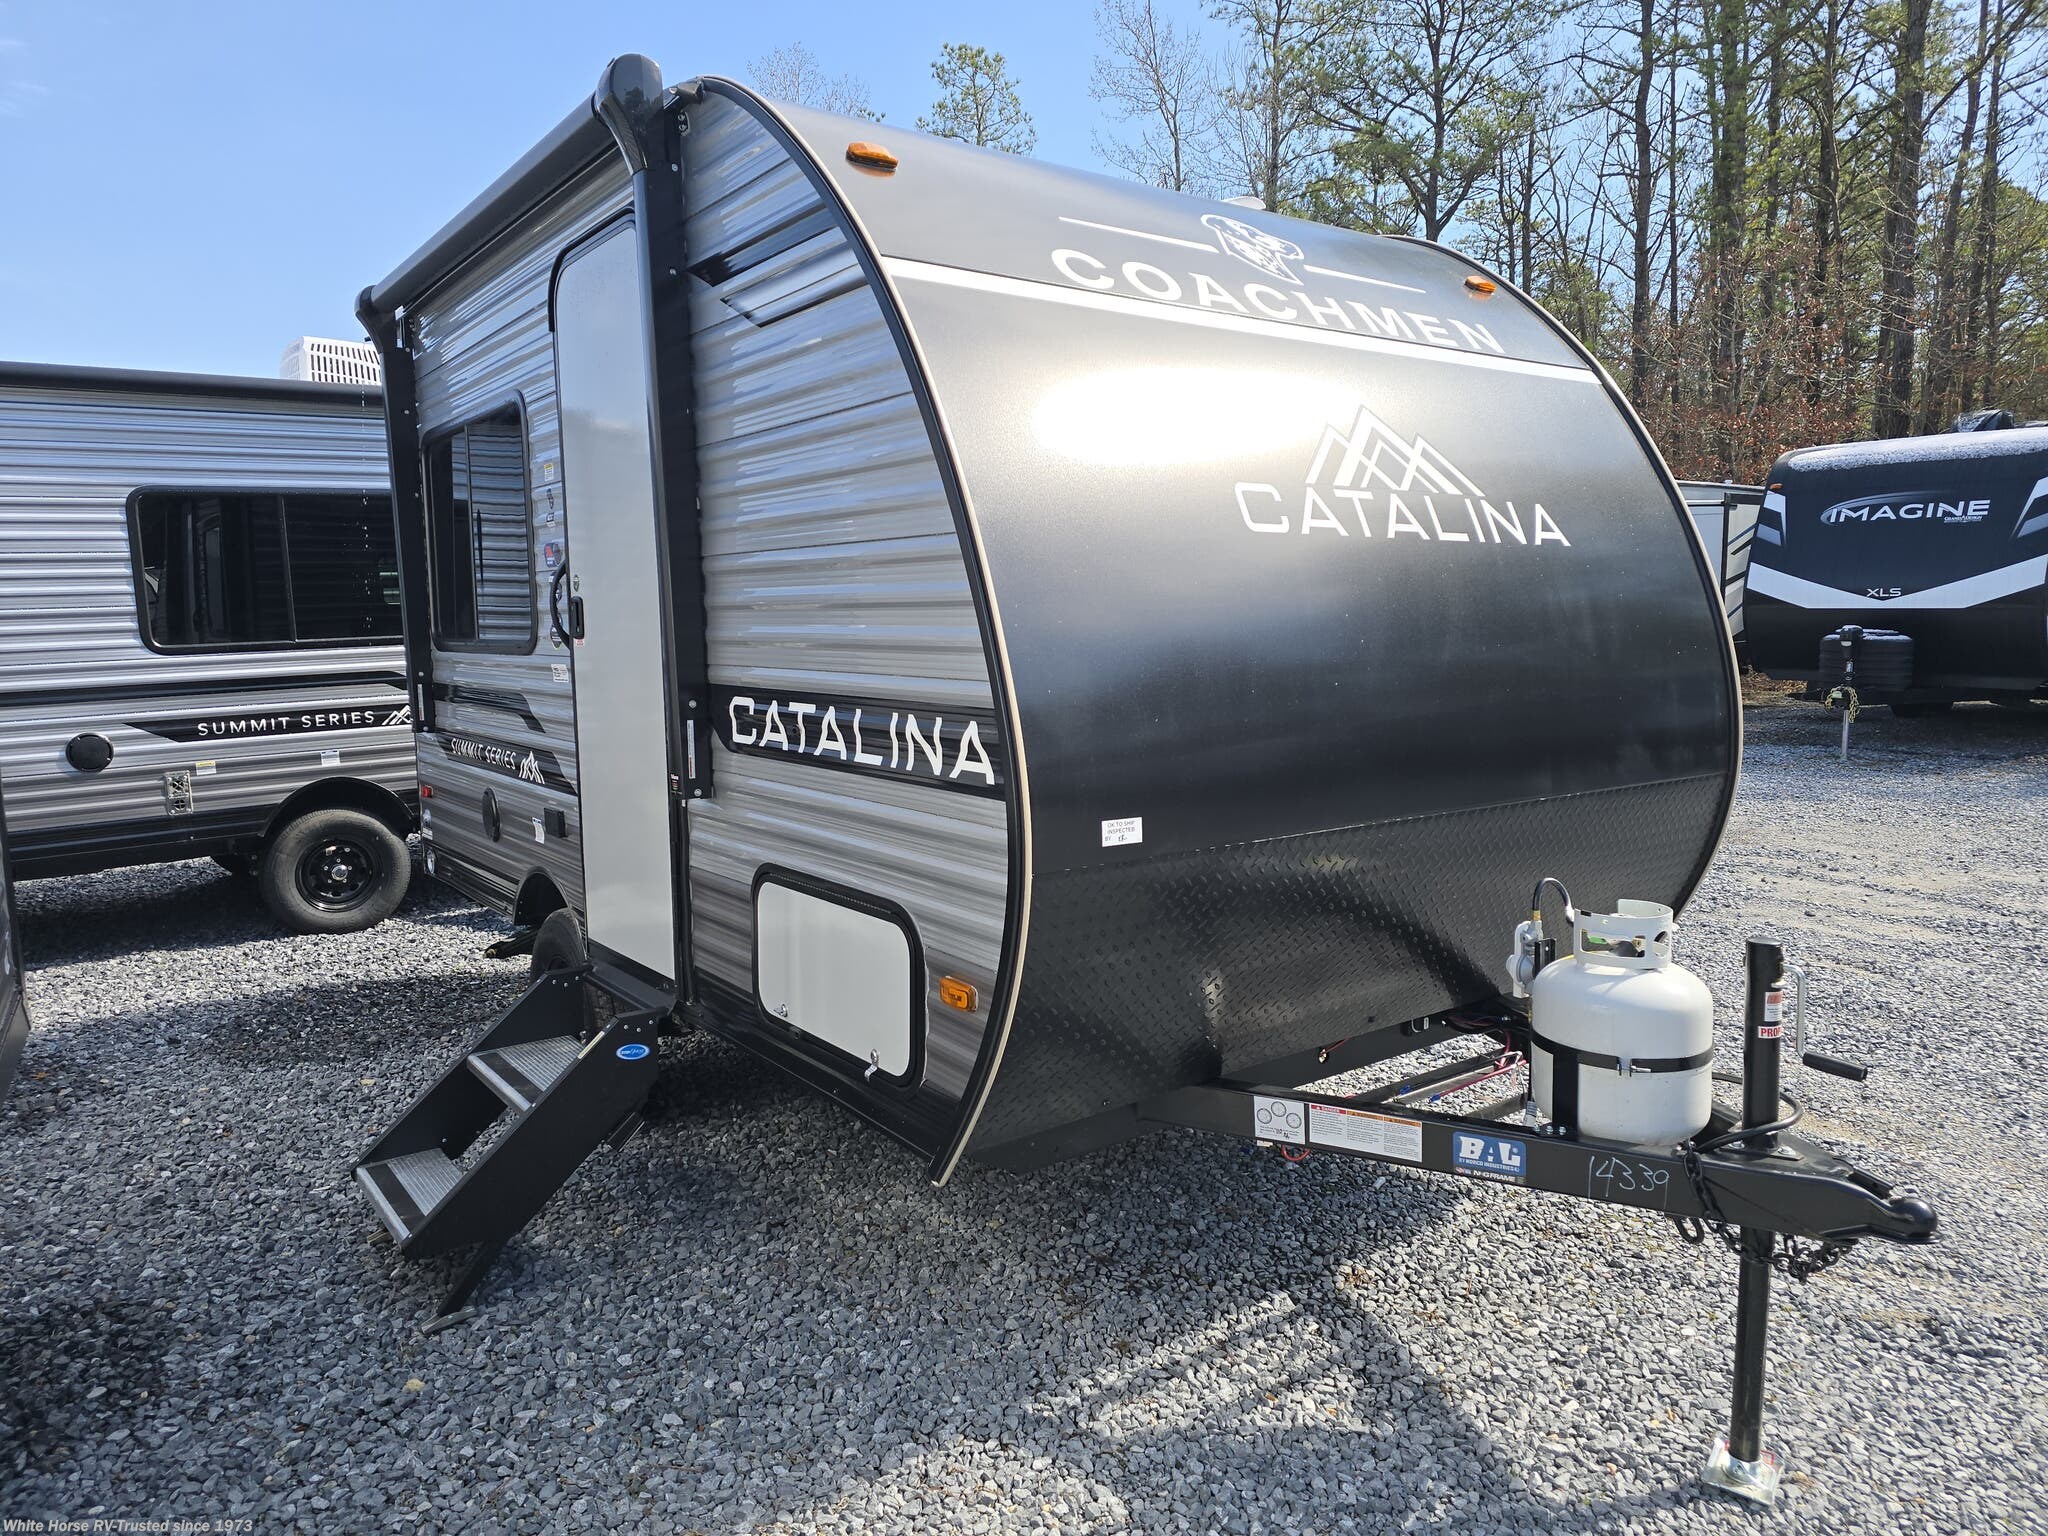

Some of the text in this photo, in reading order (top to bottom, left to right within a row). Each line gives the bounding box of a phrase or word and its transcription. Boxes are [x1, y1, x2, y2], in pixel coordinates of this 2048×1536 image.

[1051, 247, 1505, 354] COACHMEN
[1234, 481, 1572, 548] CATALINA
[1829, 499, 1991, 523] IMAGINE
[1866, 588, 1902, 598] XLS
[197, 710, 375, 736] SUMMIT SERIES
[451, 738, 516, 770] SUMMIT SERIES
[728, 695, 996, 786] CATALINA
[1484, 1161, 1514, 1172] INDUSTRIES
[1587, 1155, 1670, 1211] 14339
